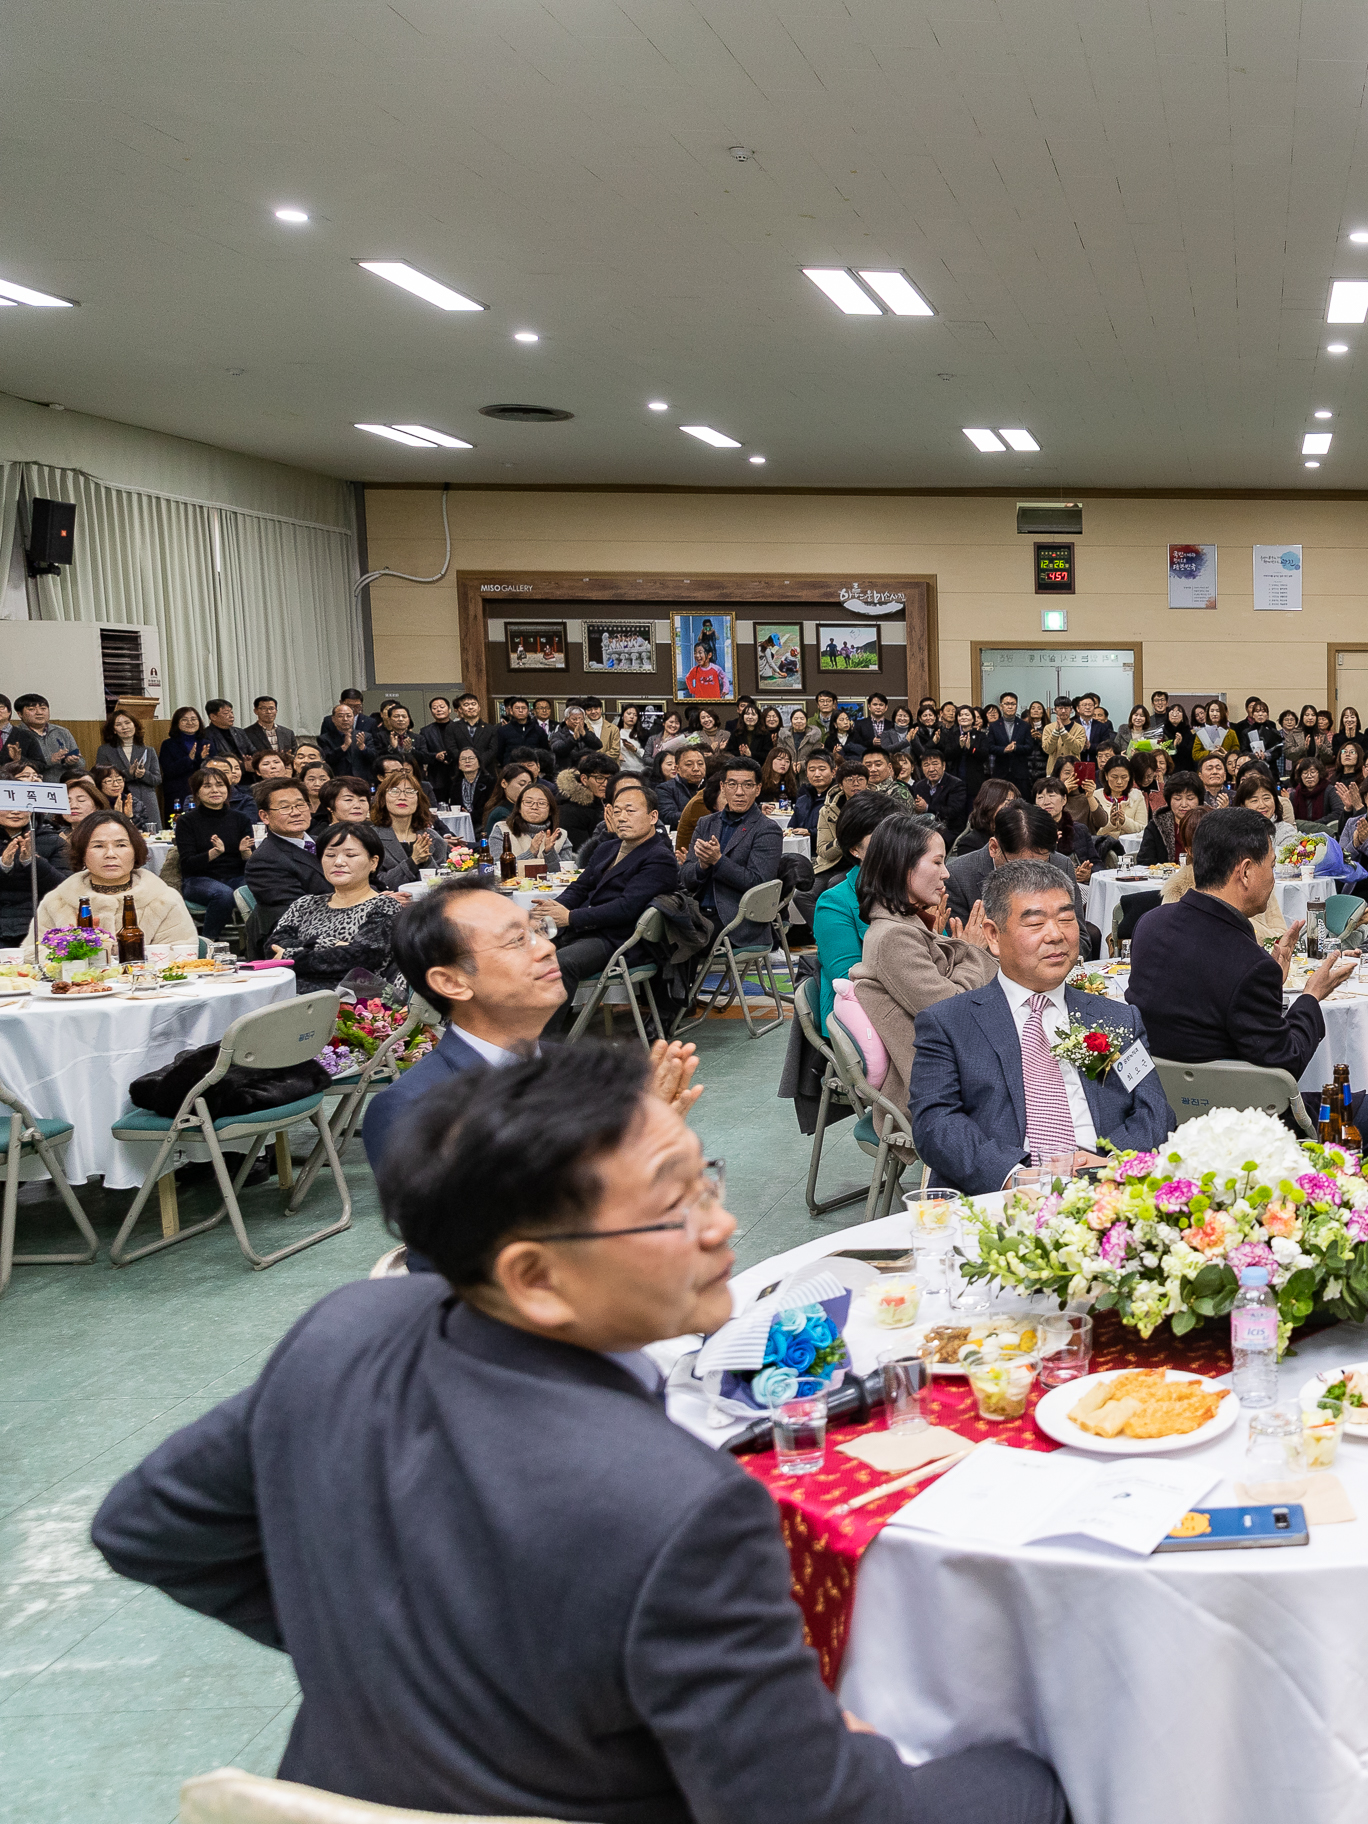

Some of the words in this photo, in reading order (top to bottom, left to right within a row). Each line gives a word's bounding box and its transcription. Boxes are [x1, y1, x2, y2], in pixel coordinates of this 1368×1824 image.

[1041, 560, 1049, 569] 12
[1054, 560, 1064, 569] 26
[480, 584, 501, 592] MISO
[501, 584, 533, 592] GALLERY
[1180, 1096, 1210, 1107] 광진구
